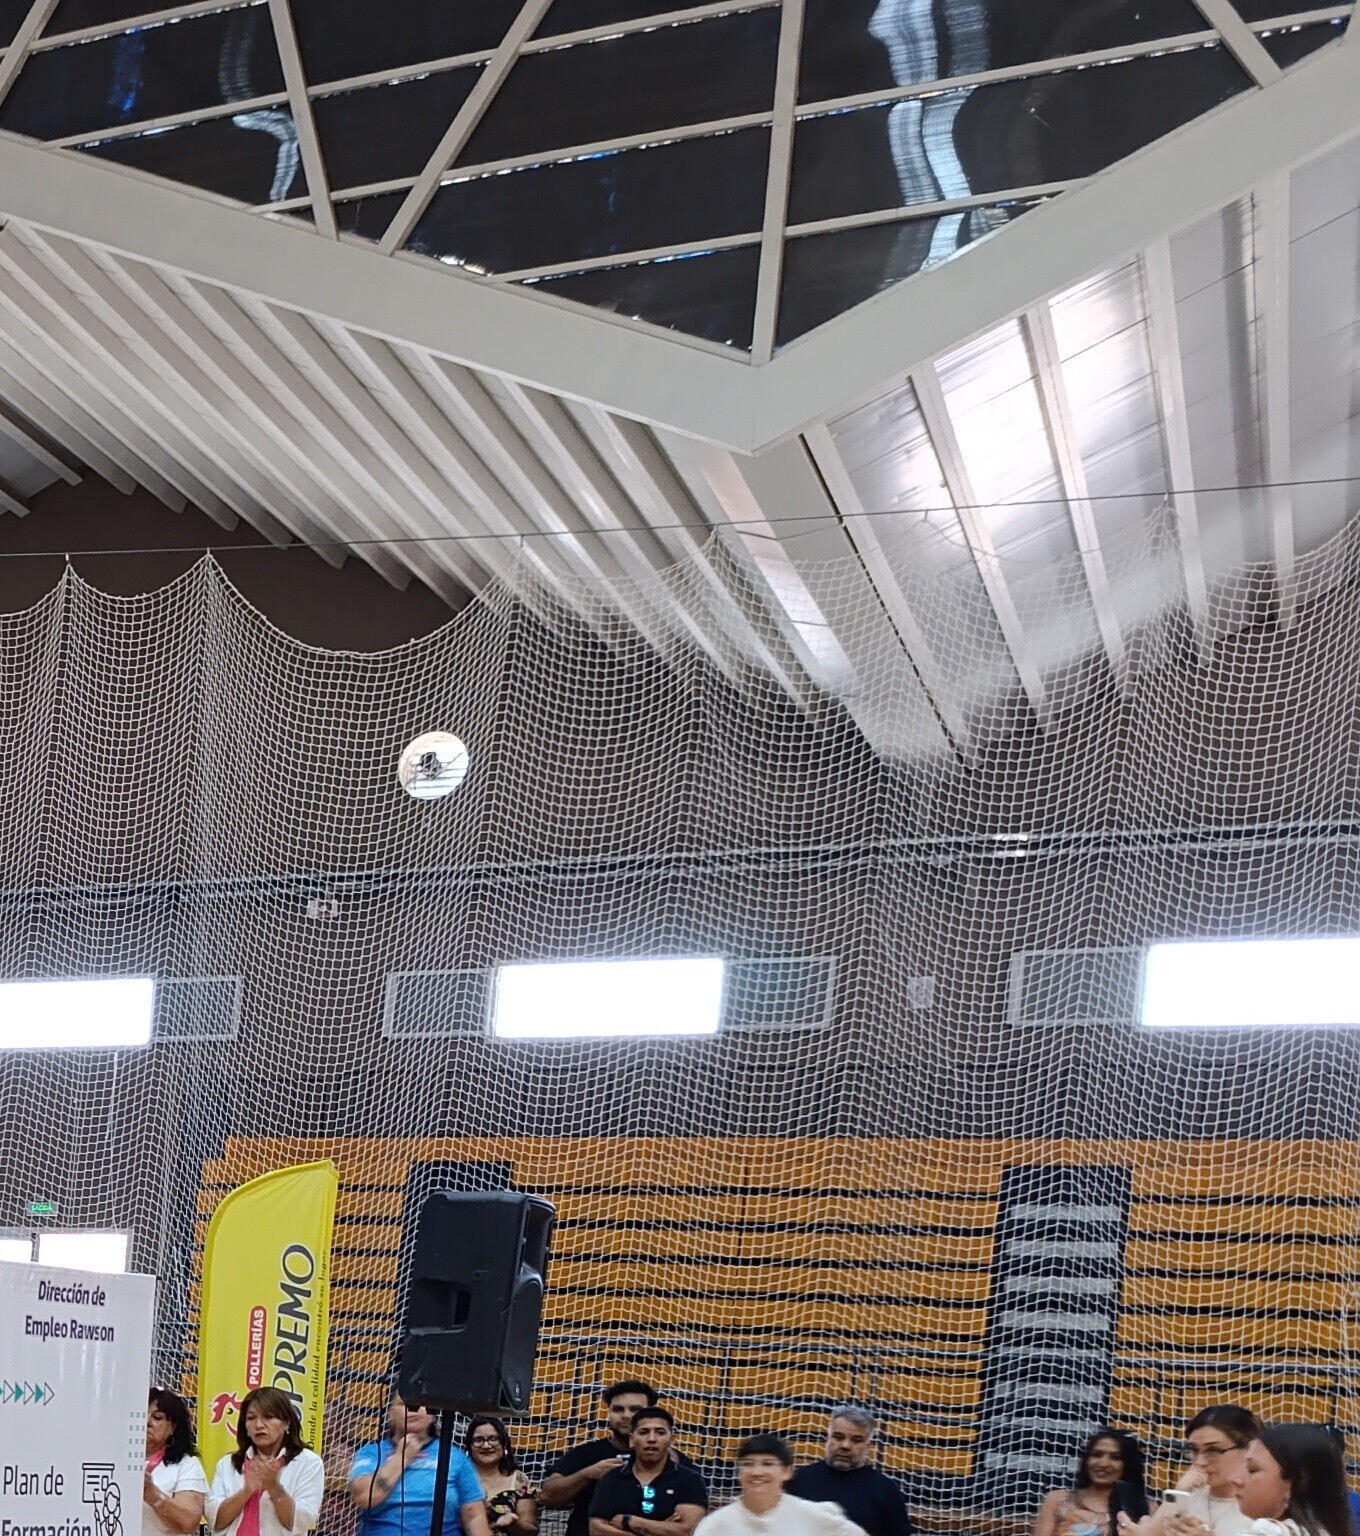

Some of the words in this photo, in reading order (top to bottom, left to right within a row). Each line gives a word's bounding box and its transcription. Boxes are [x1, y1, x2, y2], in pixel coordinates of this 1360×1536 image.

[38, 1280, 90, 1305] Dirección
[91, 1285, 105, 1307] de
[25, 1315, 68, 1342] Empleo
[70, 1318, 114, 1342] Rawson
[271, 1243, 316, 1422] PREMO
[249, 1308, 266, 1386] POLLERÍAS
[310, 1355, 320, 1398] calidad
[309, 1401, 318, 1412] la
[3, 1465, 40, 1496] Plan
[43, 1469, 64, 1496] de
